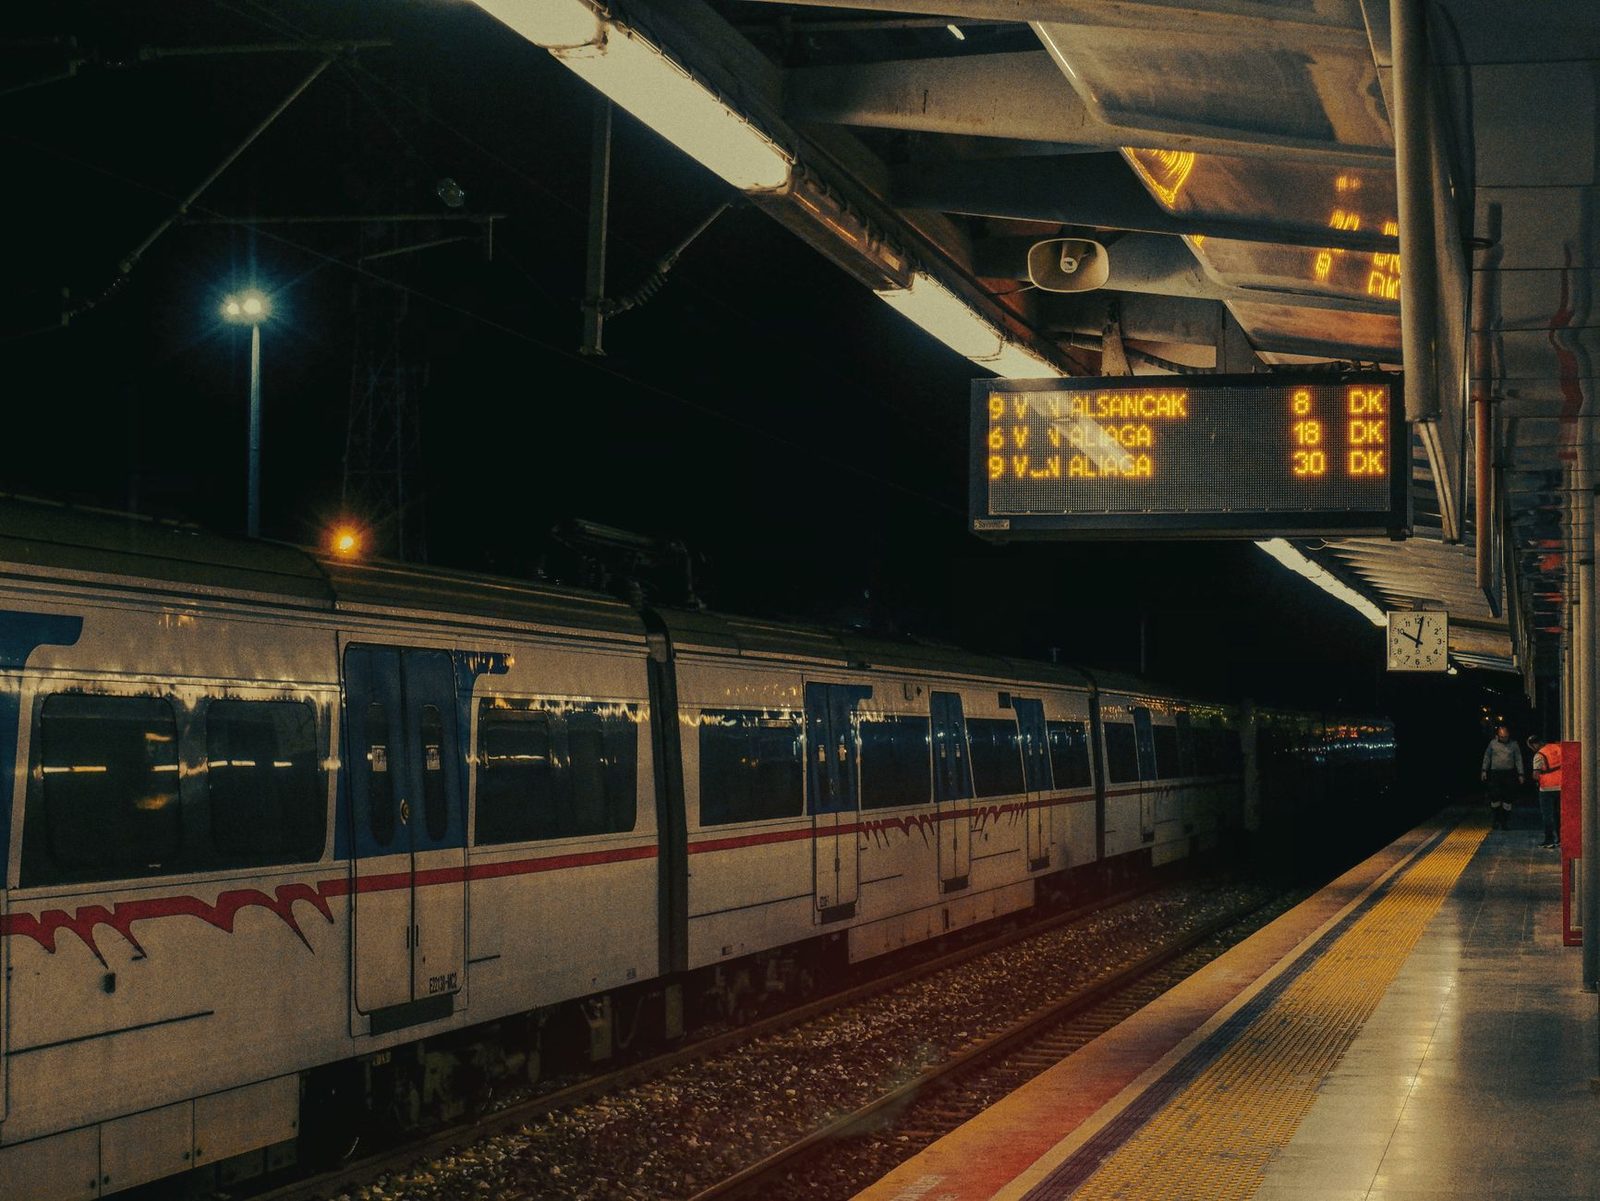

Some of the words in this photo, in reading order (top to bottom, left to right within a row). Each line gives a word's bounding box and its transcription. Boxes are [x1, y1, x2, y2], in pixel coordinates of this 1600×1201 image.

[990, 395, 1004, 419] 9
[1071, 393, 1187, 417] ALSANCAK
[1293, 390, 1310, 414] 8
[1349, 389, 1384, 413] DK
[989, 426, 1004, 449] 6
[1293, 421, 1320, 445] 18
[1349, 420, 1384, 444] DK
[989, 455, 1004, 479] 9
[1293, 451, 1325, 475] 30
[1349, 450, 1384, 474] DK
